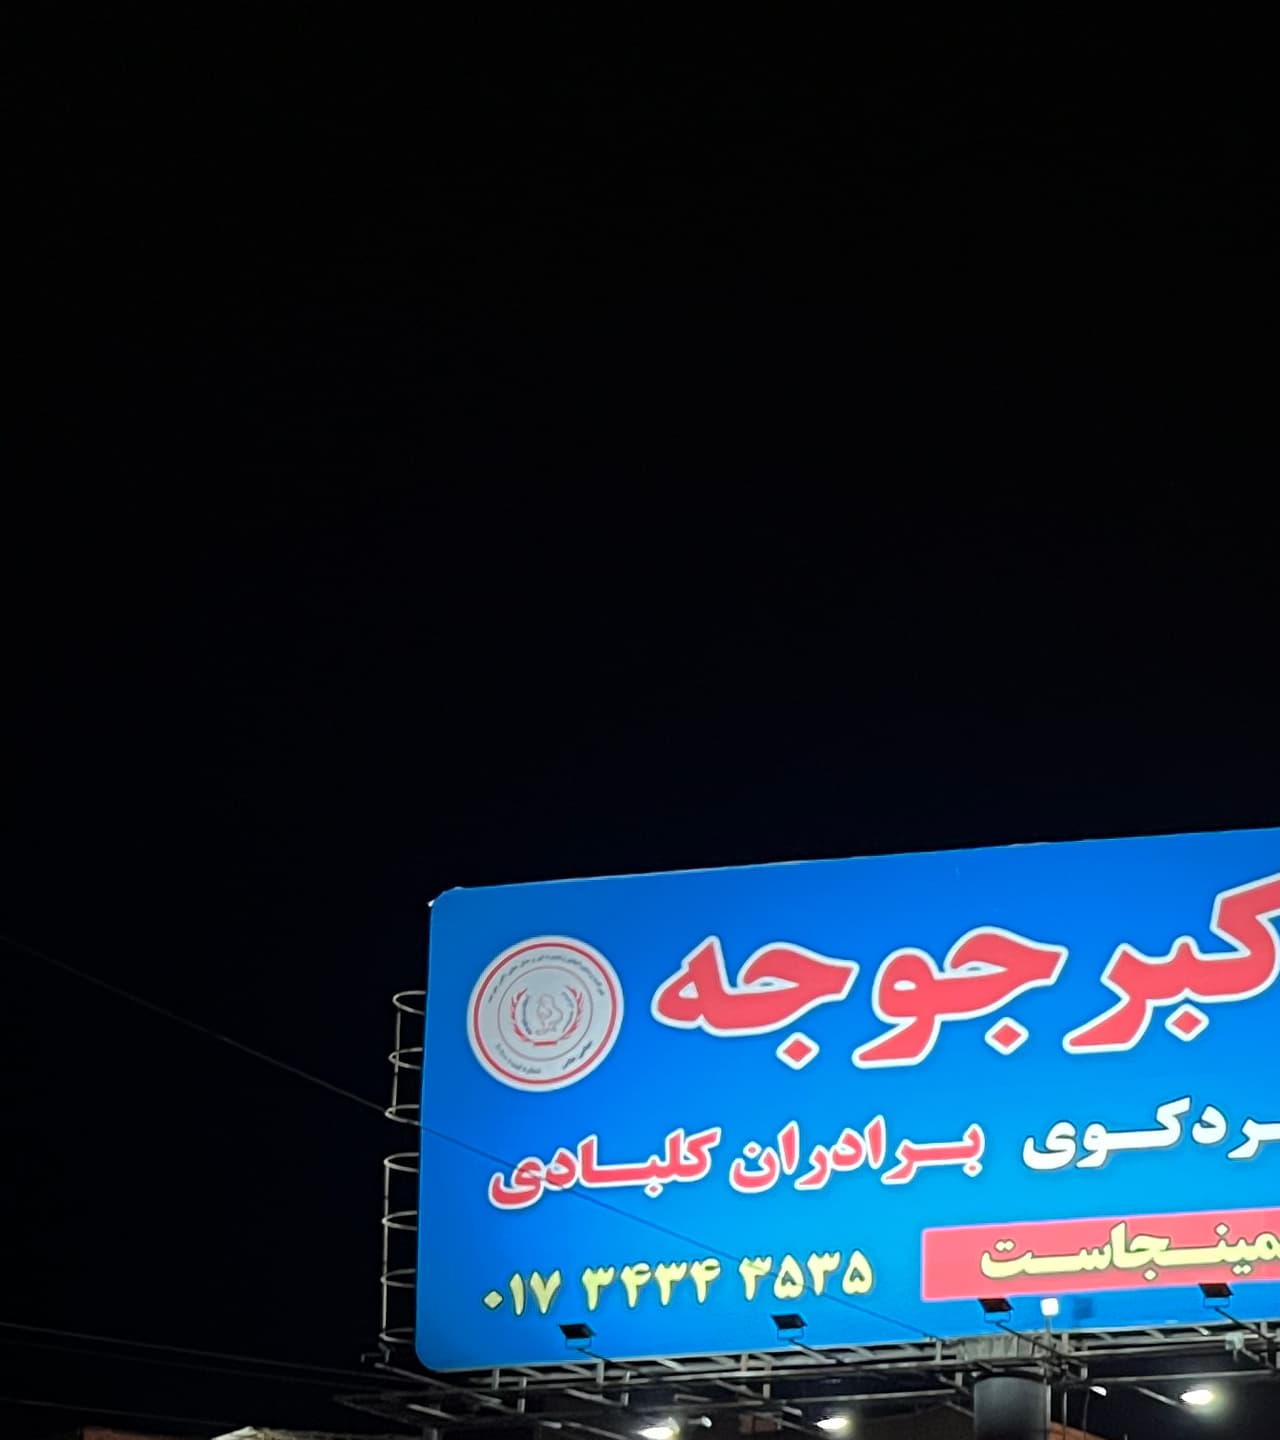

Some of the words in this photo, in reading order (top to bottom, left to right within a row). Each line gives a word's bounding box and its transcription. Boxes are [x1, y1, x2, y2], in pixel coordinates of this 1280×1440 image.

[652, 926, 1068, 1069] جوجه
[489, 1126, 722, 1210] کلبادی
[729, 1115, 985, 1194] برادران
[483, 1269, 562, 1316] ۰۱۷
[581, 1256, 722, 1311] ۳۴۳۴
[738, 1248, 873, 1301] ۳۵۳۵
